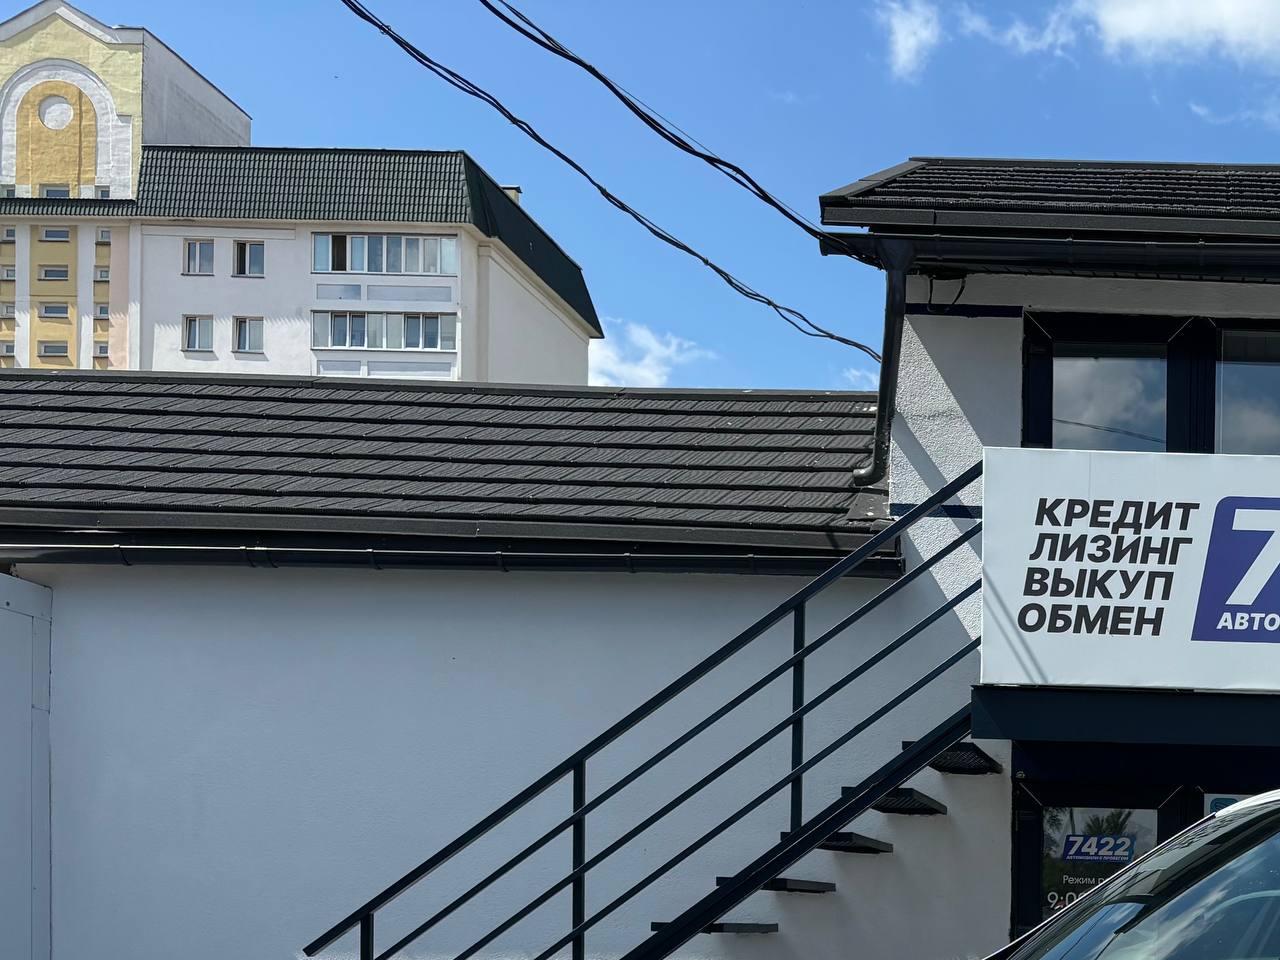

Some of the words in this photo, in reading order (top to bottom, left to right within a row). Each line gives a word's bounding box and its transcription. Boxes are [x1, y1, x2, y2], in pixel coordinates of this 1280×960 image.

[1034, 498, 1200, 535] КРЕДИТ
[1029, 533, 1193, 565] ЛИЗИНГ
[1023, 567, 1174, 600] ВЫКУП
[1017, 603, 1165, 636] ОБМЕН
[1067, 836, 1131, 856] 7422
[1062, 874, 1095, 885] Режим
[1047, 891, 1085, 909] 9:0
